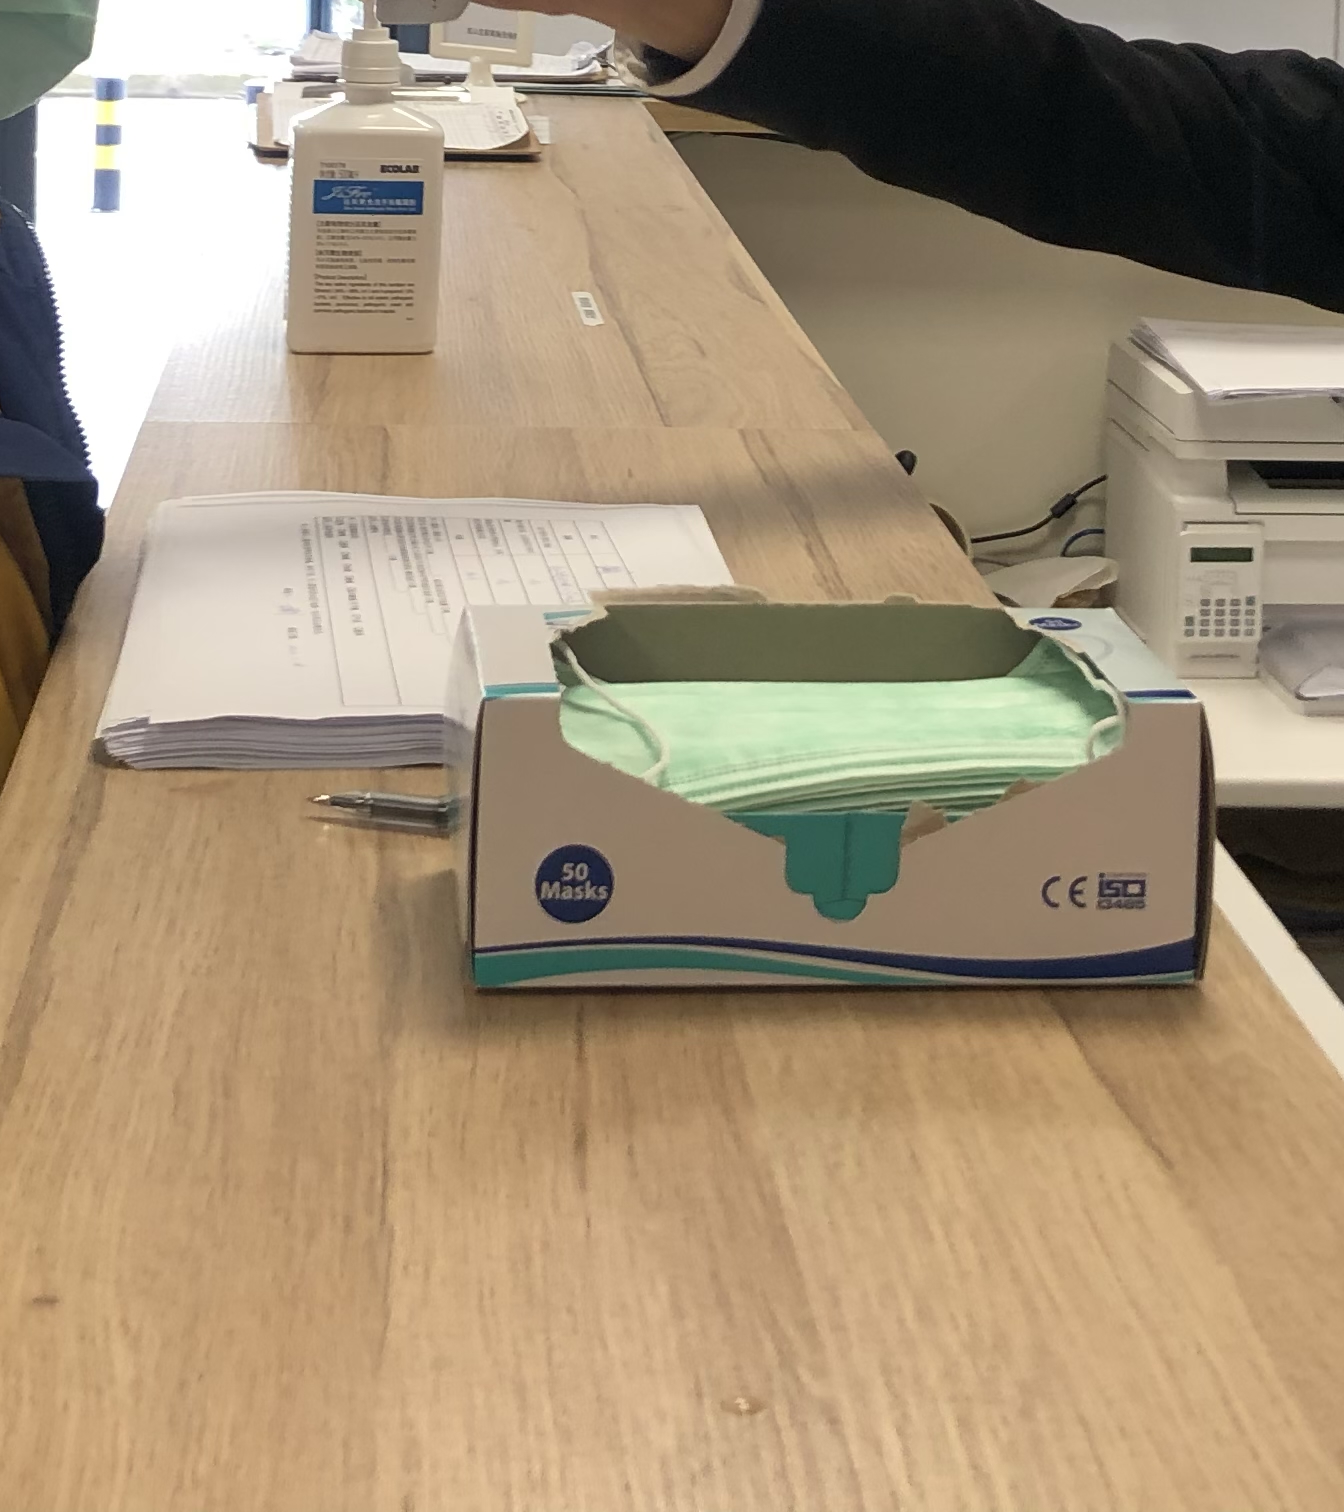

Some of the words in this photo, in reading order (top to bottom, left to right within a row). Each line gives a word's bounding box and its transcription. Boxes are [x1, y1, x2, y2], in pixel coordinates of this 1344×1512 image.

[380, 164, 420, 174] ECOLAB
[561, 862, 589, 881] 50
[540, 880, 609, 900] Masks
